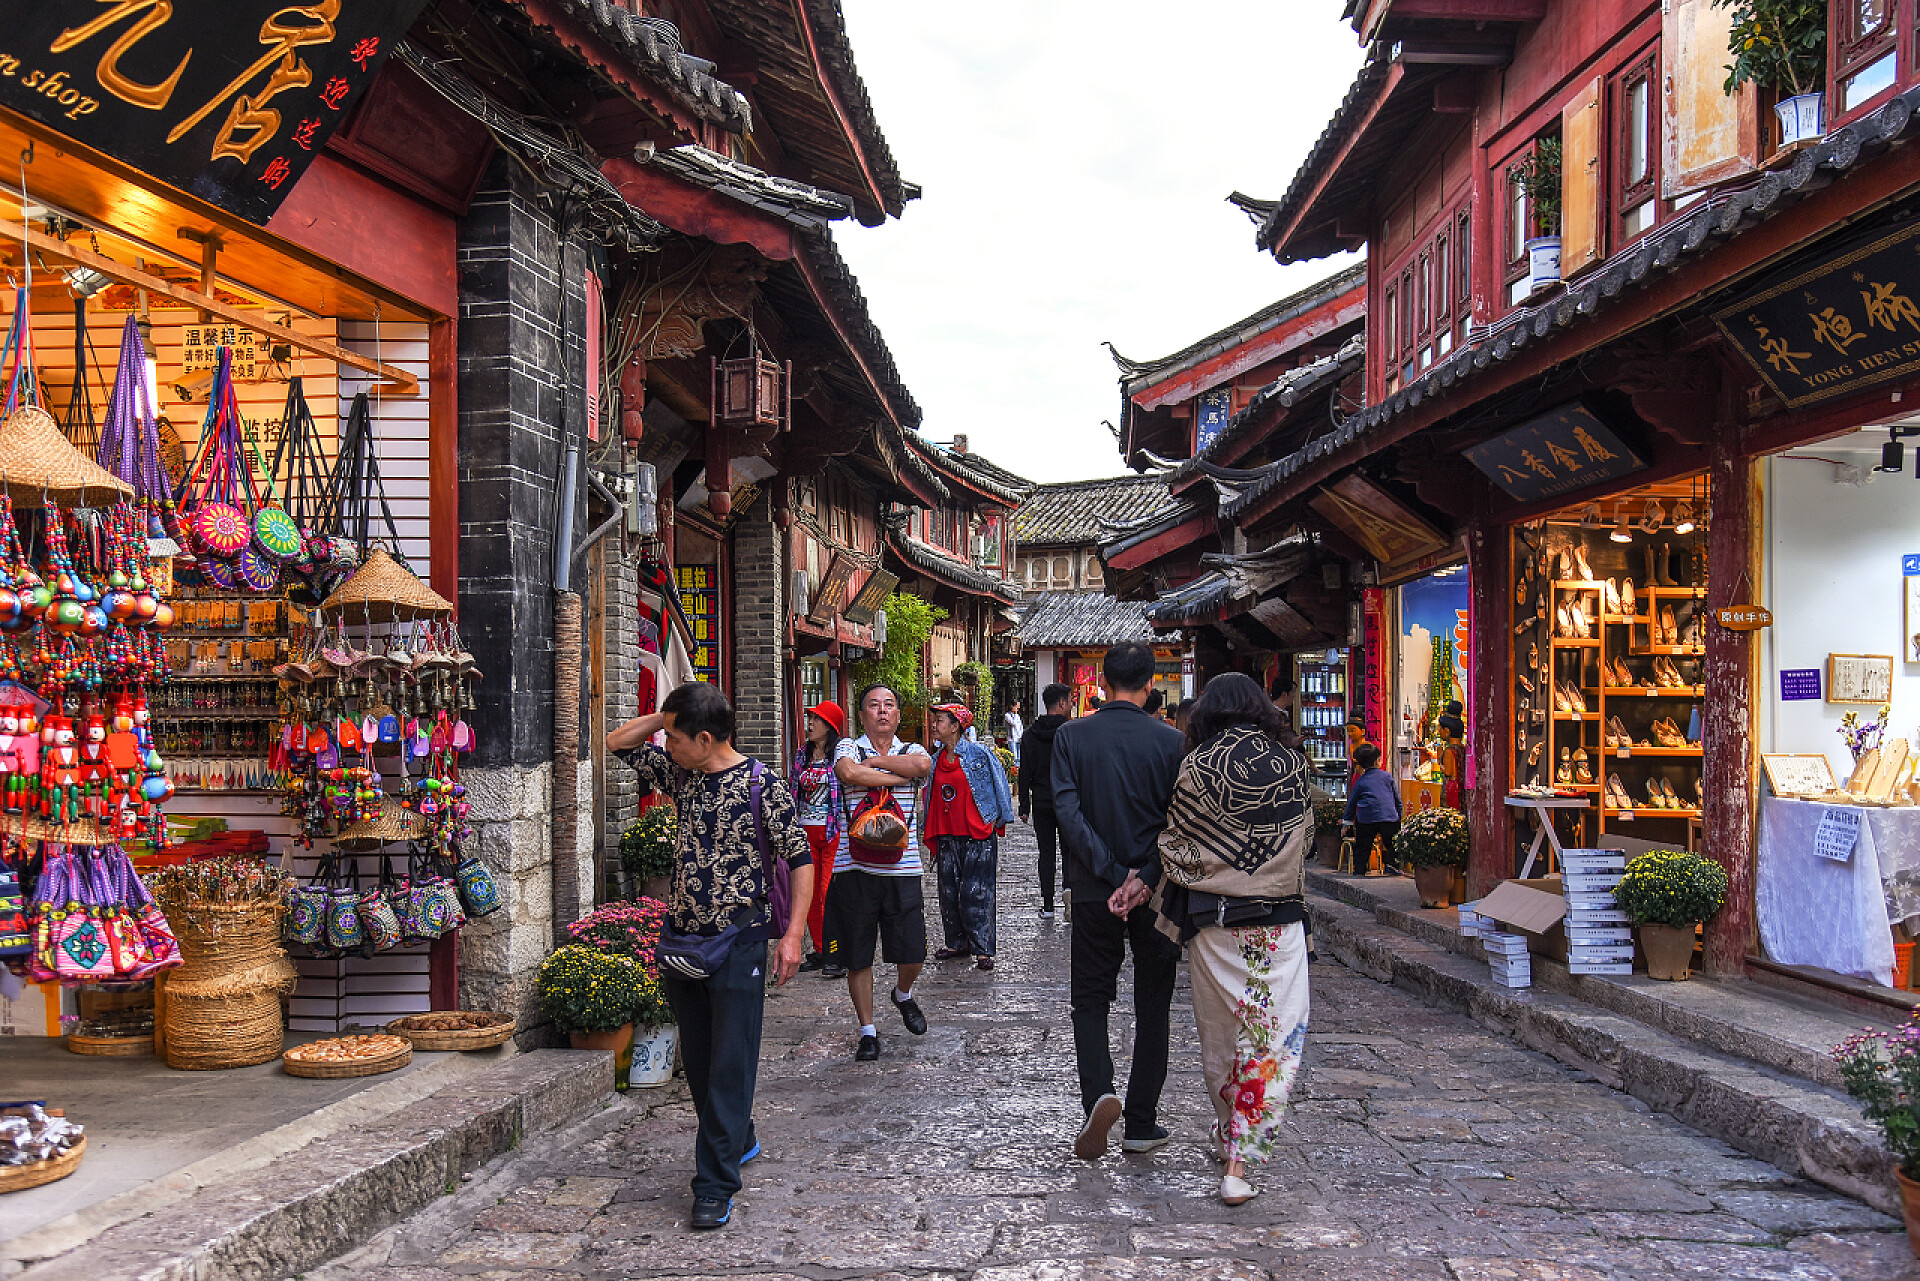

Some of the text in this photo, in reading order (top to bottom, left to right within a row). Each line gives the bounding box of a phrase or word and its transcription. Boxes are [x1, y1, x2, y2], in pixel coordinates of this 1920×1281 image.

[21, 69, 101, 121] shop
[185, 328, 253, 346] 温馨提示
[184, 347, 255, 362] 请带好物品
[1803, 364, 1854, 388] YONG
[1857, 347, 1901, 371] HEN
[1721, 611, 1770, 623] 原创手作
